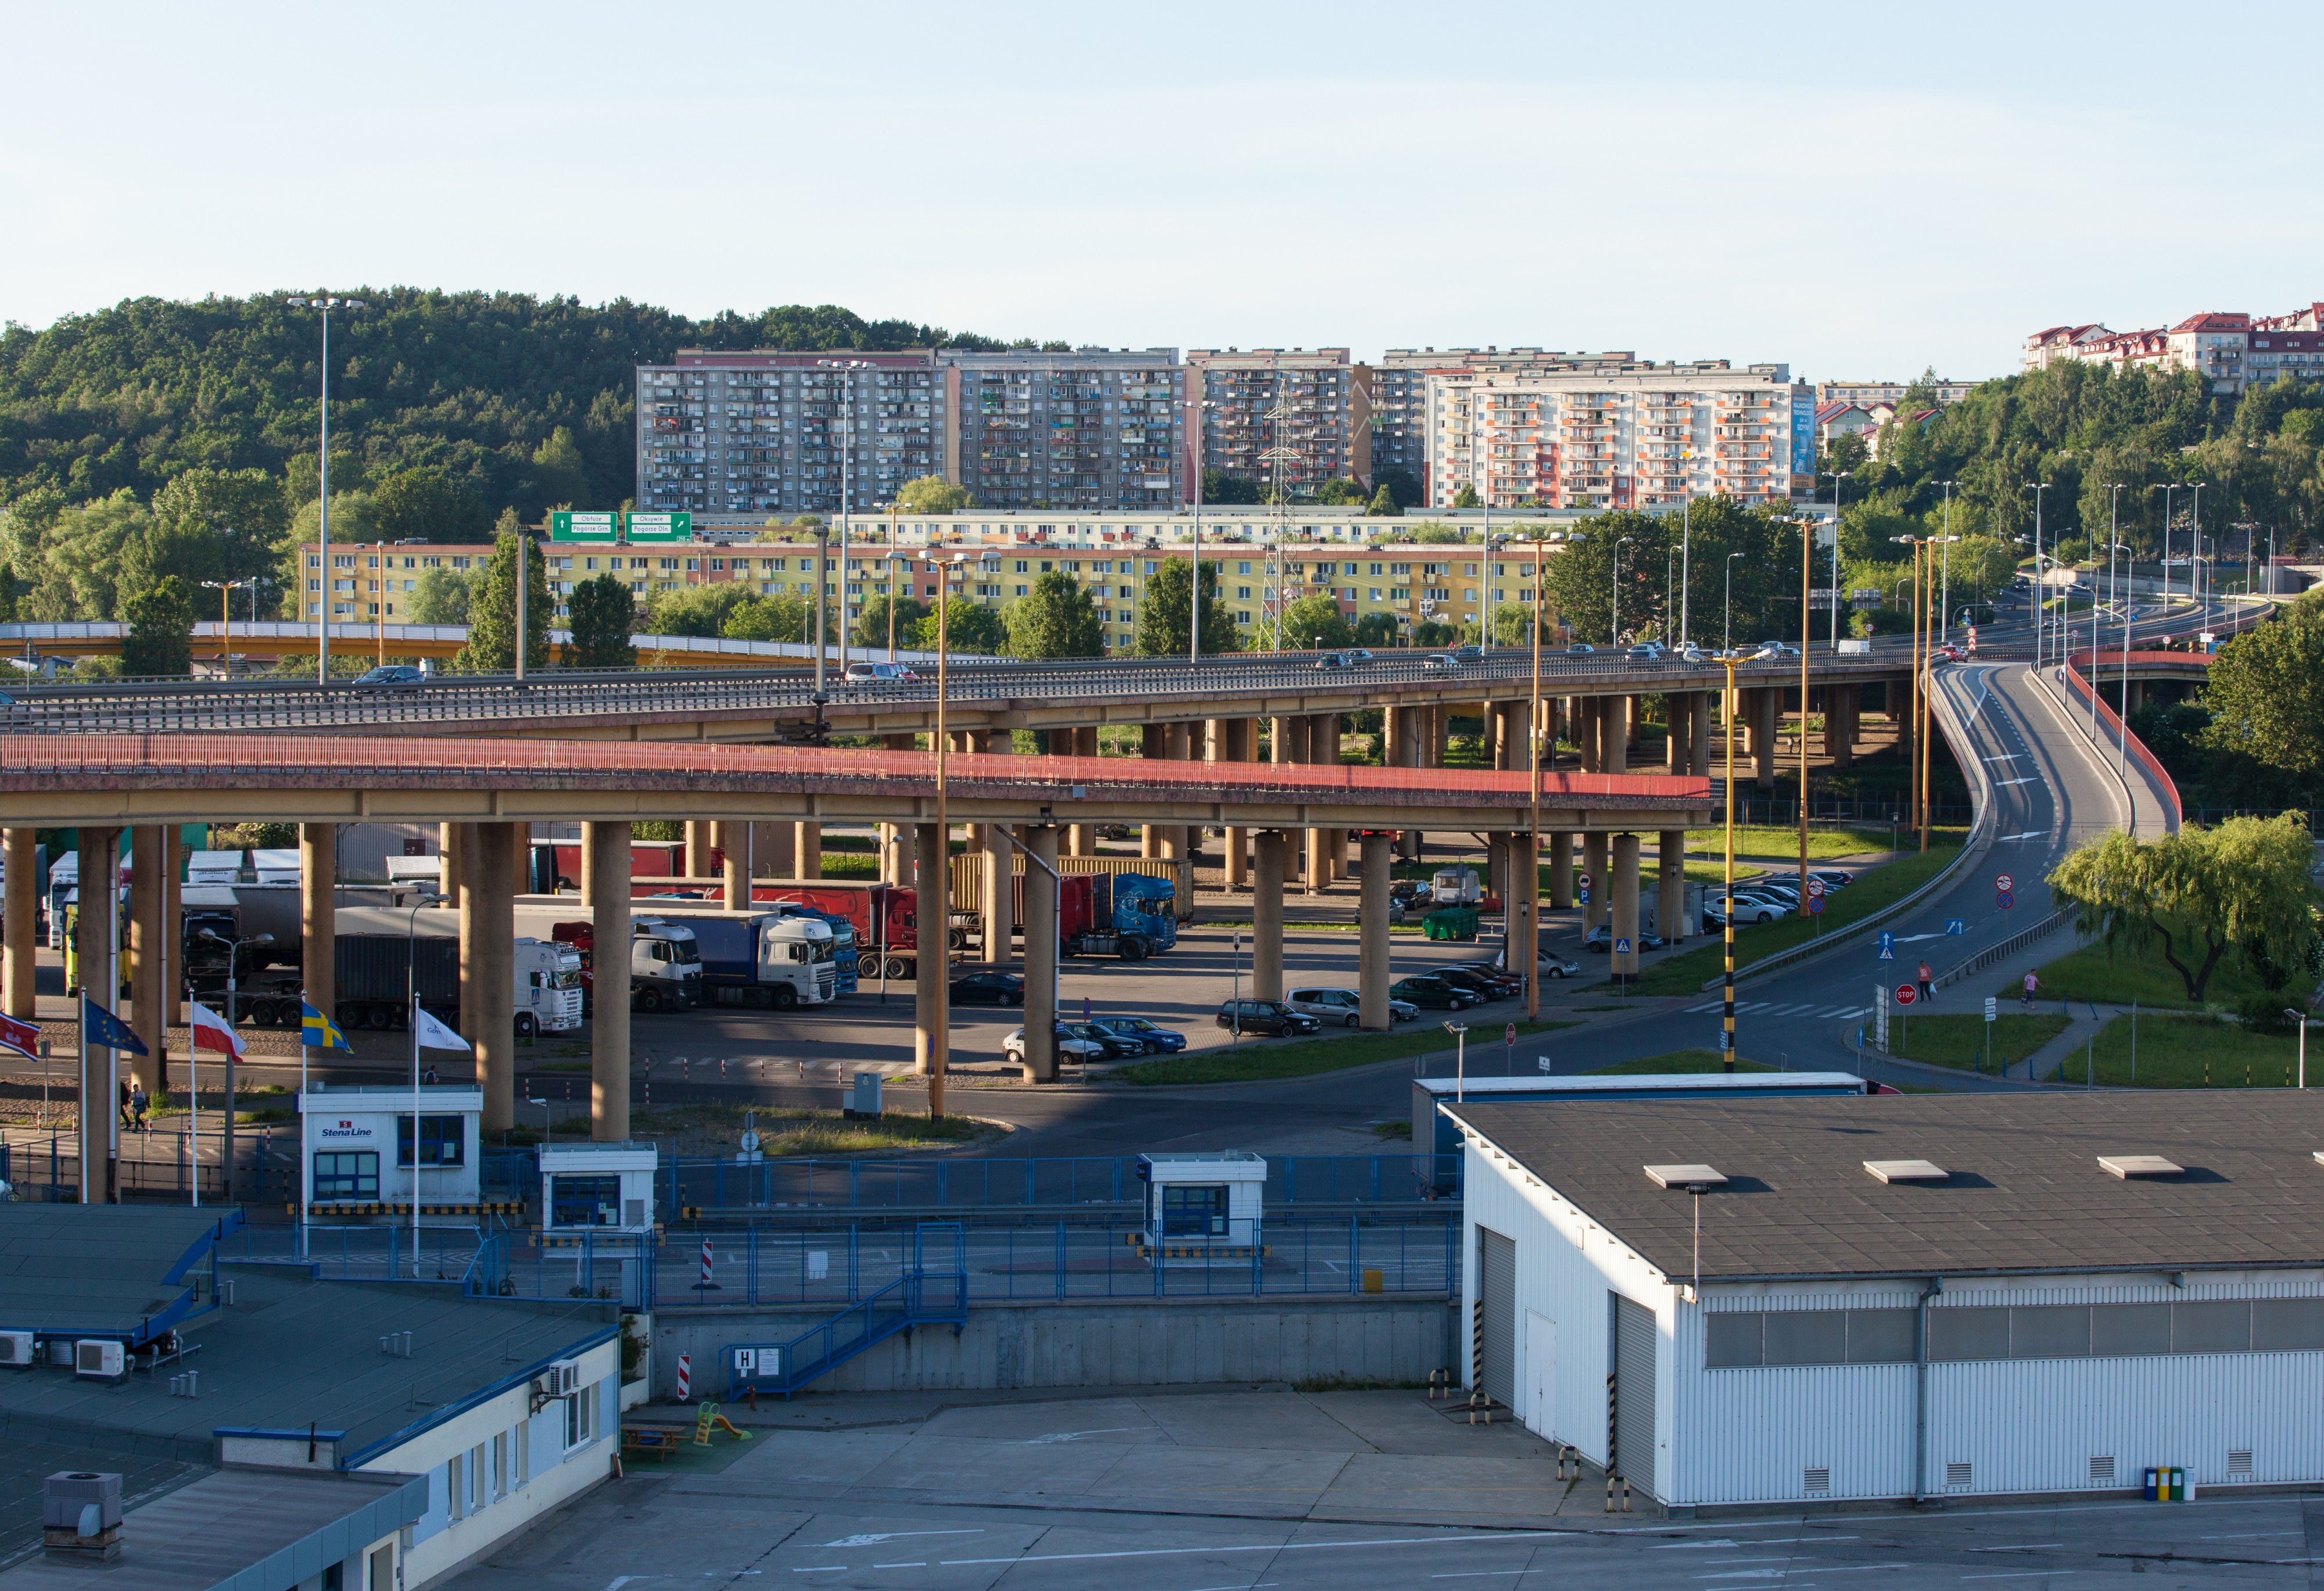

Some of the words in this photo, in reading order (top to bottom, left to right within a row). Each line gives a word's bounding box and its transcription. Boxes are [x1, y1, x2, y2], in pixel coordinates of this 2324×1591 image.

[1581, 890, 1588, 900] P
[1507, 1031, 1515, 1039] STOP
[322, 1128, 350, 1137] Stena
[351, 1128, 372, 1136] Line
[741, 1351, 749, 1367] H
